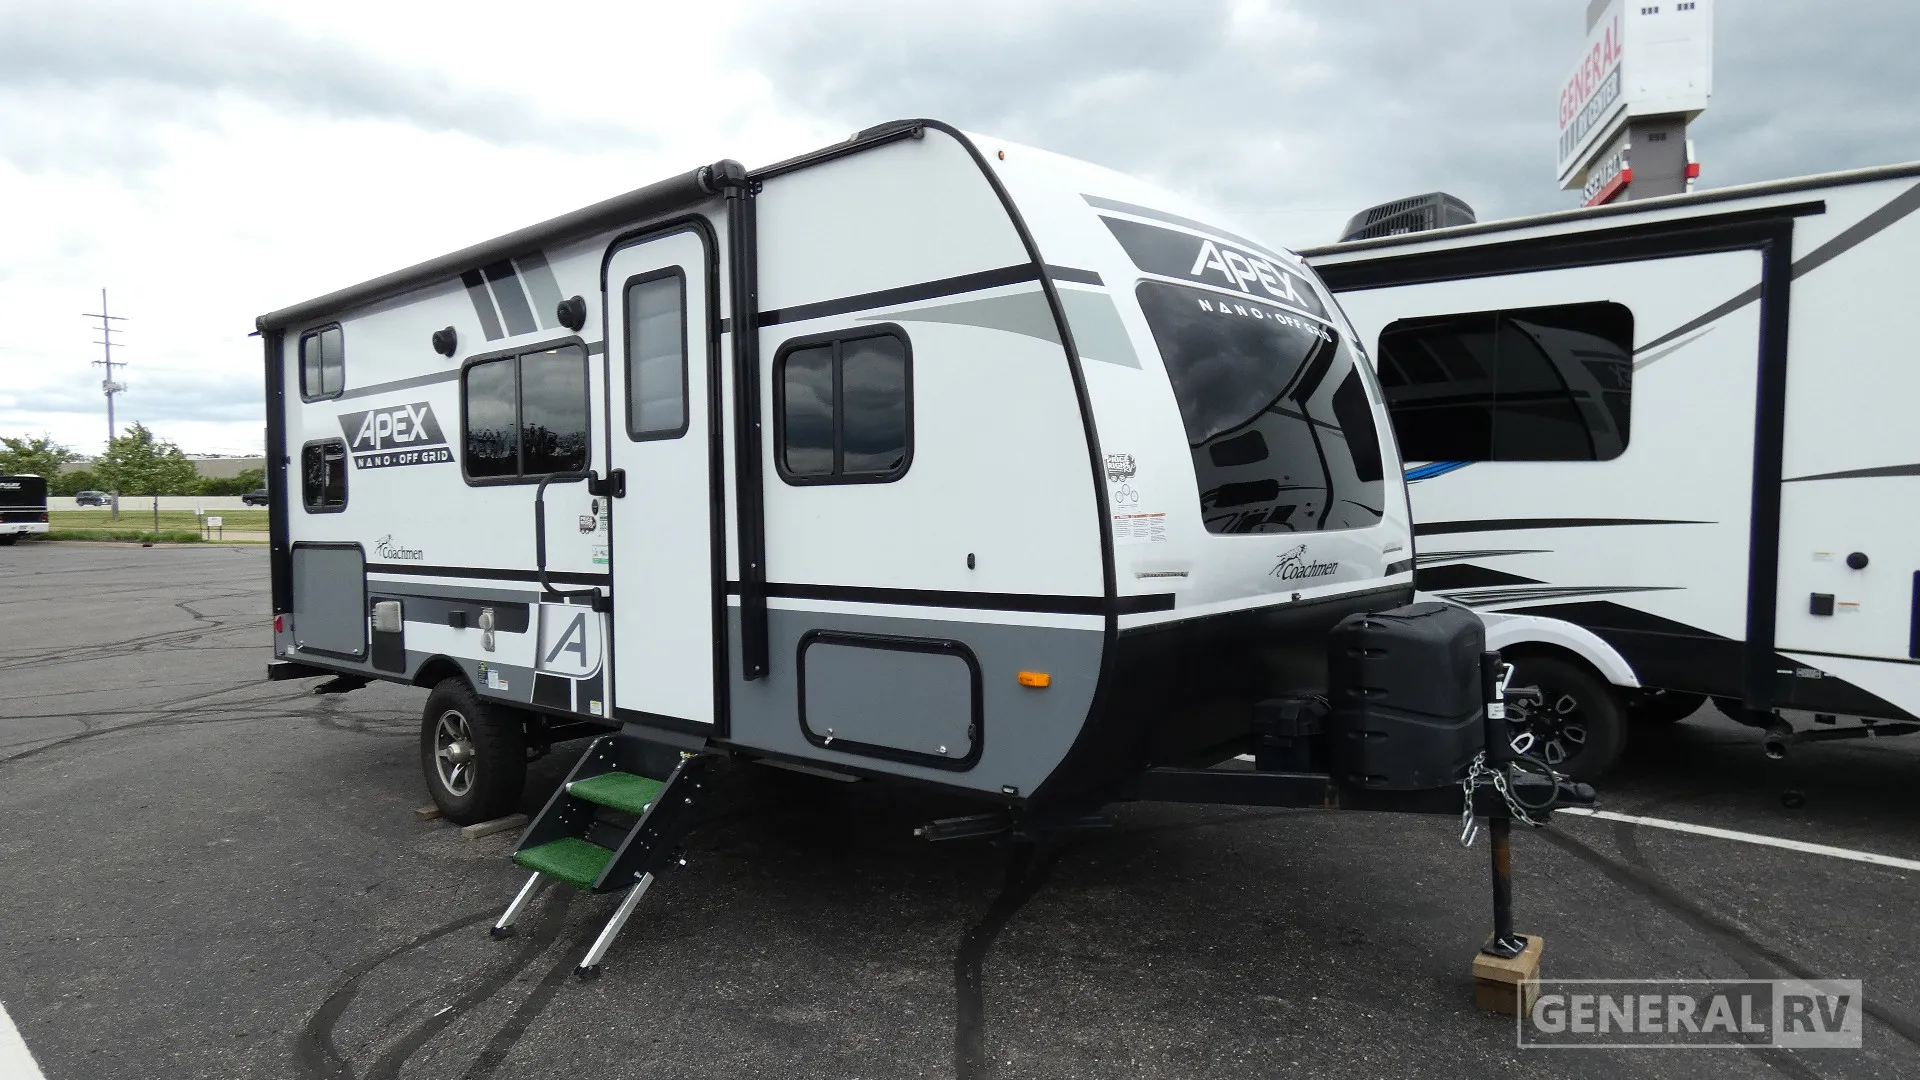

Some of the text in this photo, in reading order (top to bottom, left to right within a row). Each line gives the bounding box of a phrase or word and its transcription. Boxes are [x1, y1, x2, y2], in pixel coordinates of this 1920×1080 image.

[1560, 15, 1621, 129] GENERAL
[1190, 240, 1309, 308] APEX
[1198, 299, 1332, 342] NANO OFF GRID
[353, 404, 428, 450] APEX
[358, 450, 448, 467] NANO OFF GRID
[383, 546, 423, 560] Coachmen
[1282, 560, 1338, 580] Coachmen
[544, 613, 586, 667] A
